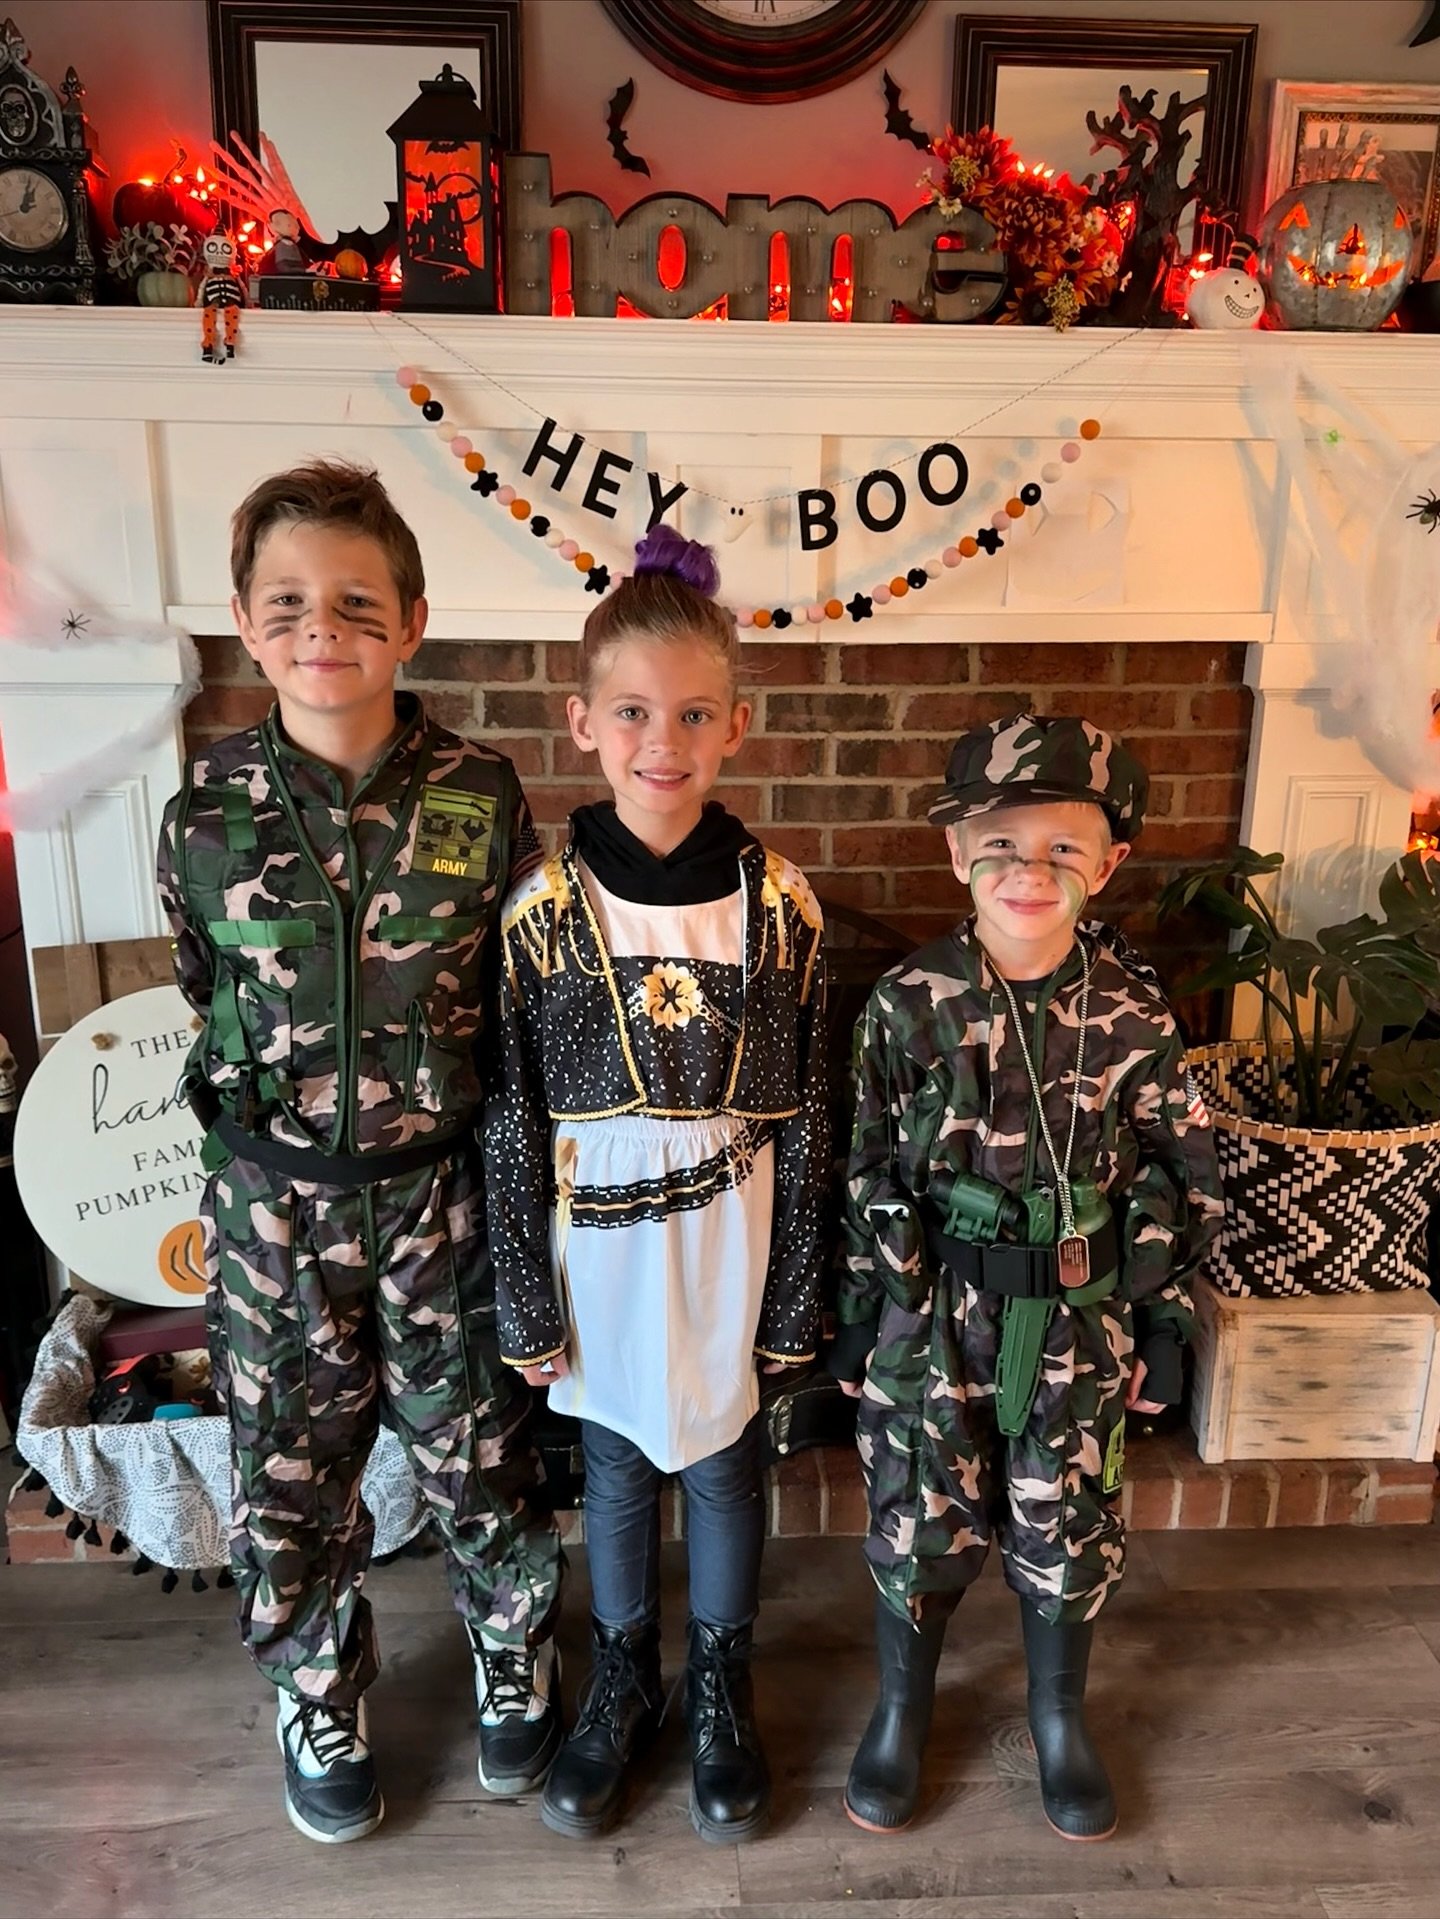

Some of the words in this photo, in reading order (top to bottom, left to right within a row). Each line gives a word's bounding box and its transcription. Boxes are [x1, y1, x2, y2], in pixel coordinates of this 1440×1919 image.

[506, 152, 1008, 323] home
[522, 417, 688, 533] HEY
[798, 443, 969, 550] BOO
[432, 858, 467, 876] ARMY
[130, 1029, 191, 1059] THE
